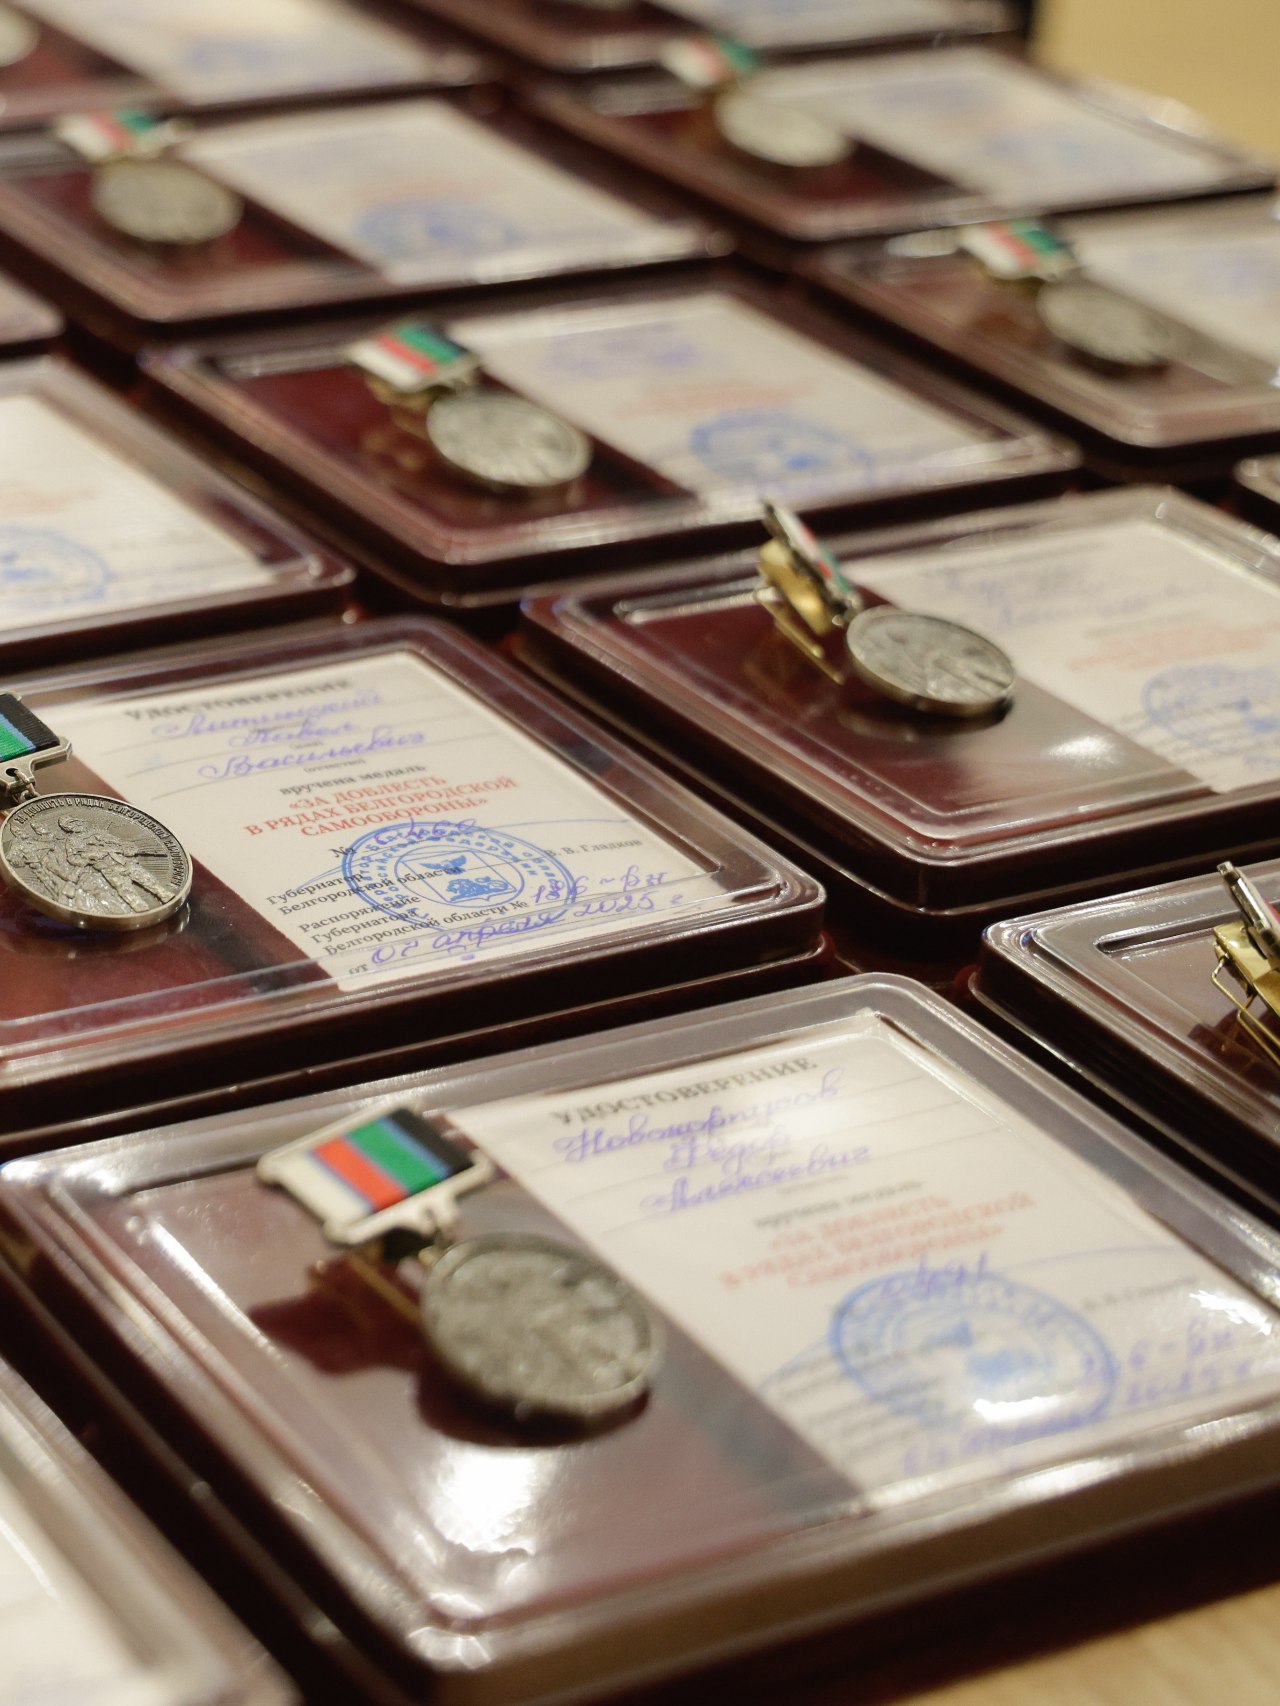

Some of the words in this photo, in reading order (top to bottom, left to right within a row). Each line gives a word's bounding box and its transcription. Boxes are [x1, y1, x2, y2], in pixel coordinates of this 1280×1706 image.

[279, 775, 355, 797] вручена
[359, 764, 427, 785] медаль
[288, 795, 331, 811] «ЗА
[331, 774, 447, 805] ДОБЛЕСТЬ
[243, 822, 263, 837] В
[265, 807, 344, 831] РЯДАХ
[345, 775, 520, 815] БЕЛГОРОДСКОЙ
[300, 797, 489, 838] САМООБОРОНЫ»
[580, 837, 643, 853] Гладков
[267, 871, 366, 905] Губернатор
[279, 877, 394, 916] Белгородской
[397, 862, 463, 891] области
[573, 892, 656, 918] 2025
[299, 894, 422, 934] Распоряжение
[311, 909, 420, 945] Губернатора
[324, 916, 441, 956] Белгородской
[443, 904, 510, 926] области
[510, 899, 530, 911] №
[549, 1056, 819, 1126] УДОСТОВЕРЕНИЕ
